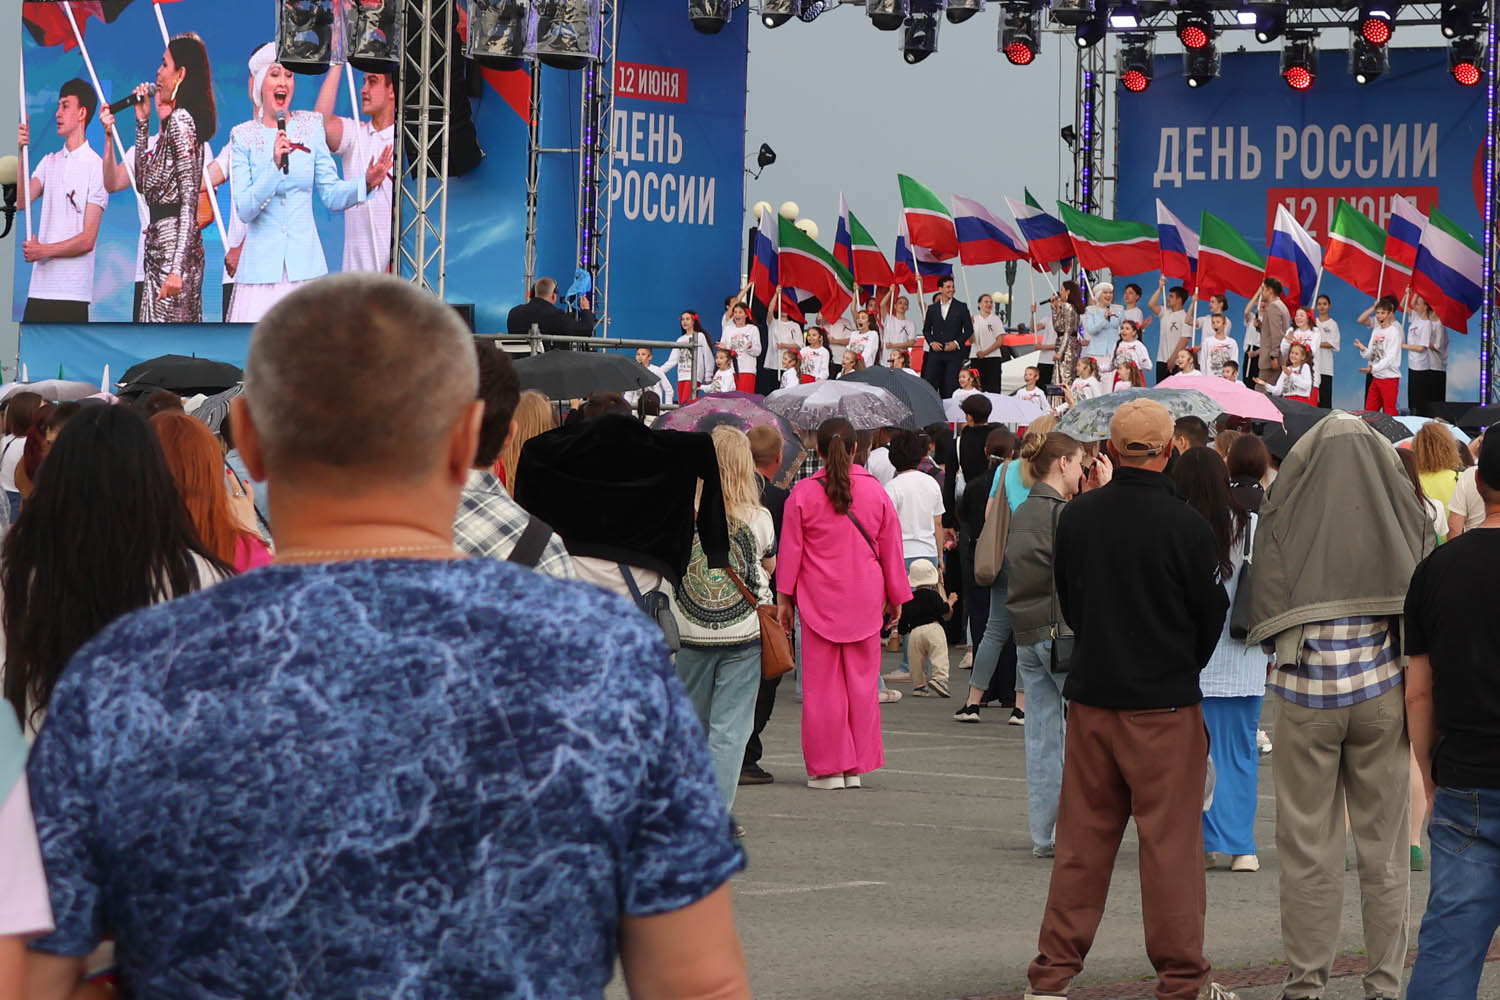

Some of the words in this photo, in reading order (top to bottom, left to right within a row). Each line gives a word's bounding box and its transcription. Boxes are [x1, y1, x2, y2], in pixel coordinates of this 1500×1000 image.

[618, 66, 635, 93] 12
[638, 68, 680, 98] ИЮНЯ
[611, 109, 683, 167] ДЕНЬ
[1153, 125, 1263, 188] ДЕНЬ
[1275, 122, 1438, 181] РОССИИ
[611, 169, 716, 226] РОССИИ
